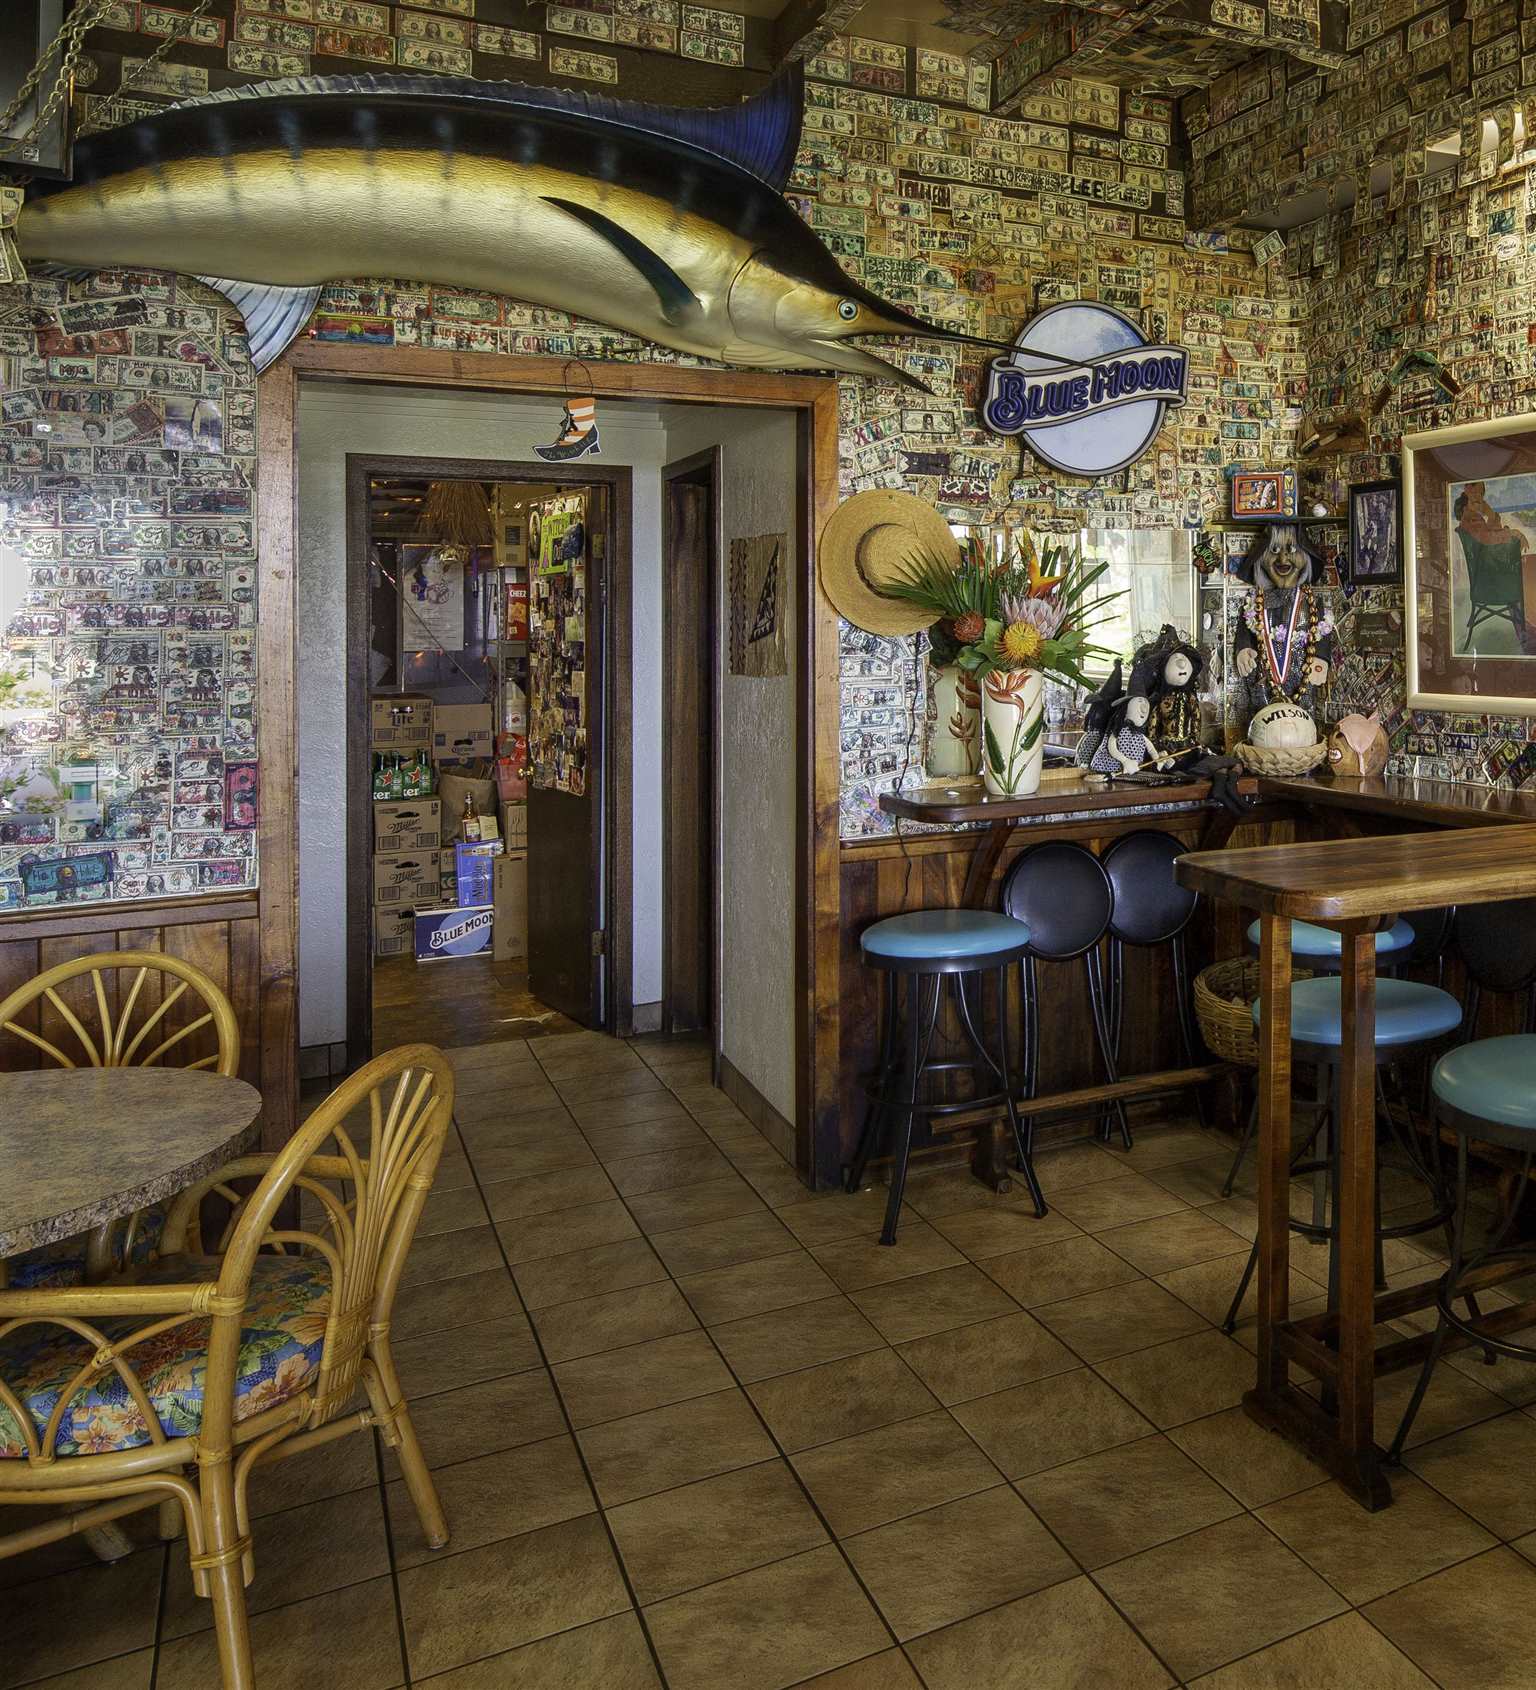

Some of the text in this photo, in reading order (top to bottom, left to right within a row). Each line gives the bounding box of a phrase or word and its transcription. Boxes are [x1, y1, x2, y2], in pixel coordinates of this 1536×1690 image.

[910, 355, 949, 369] NEVADA
[991, 356, 1184, 431] BLUE MOON
[1261, 709, 1311, 725] WILSON
[387, 818, 422, 834] Miller
[389, 869, 422, 884] Miller
[431, 913, 494, 948] BLUE MOON
